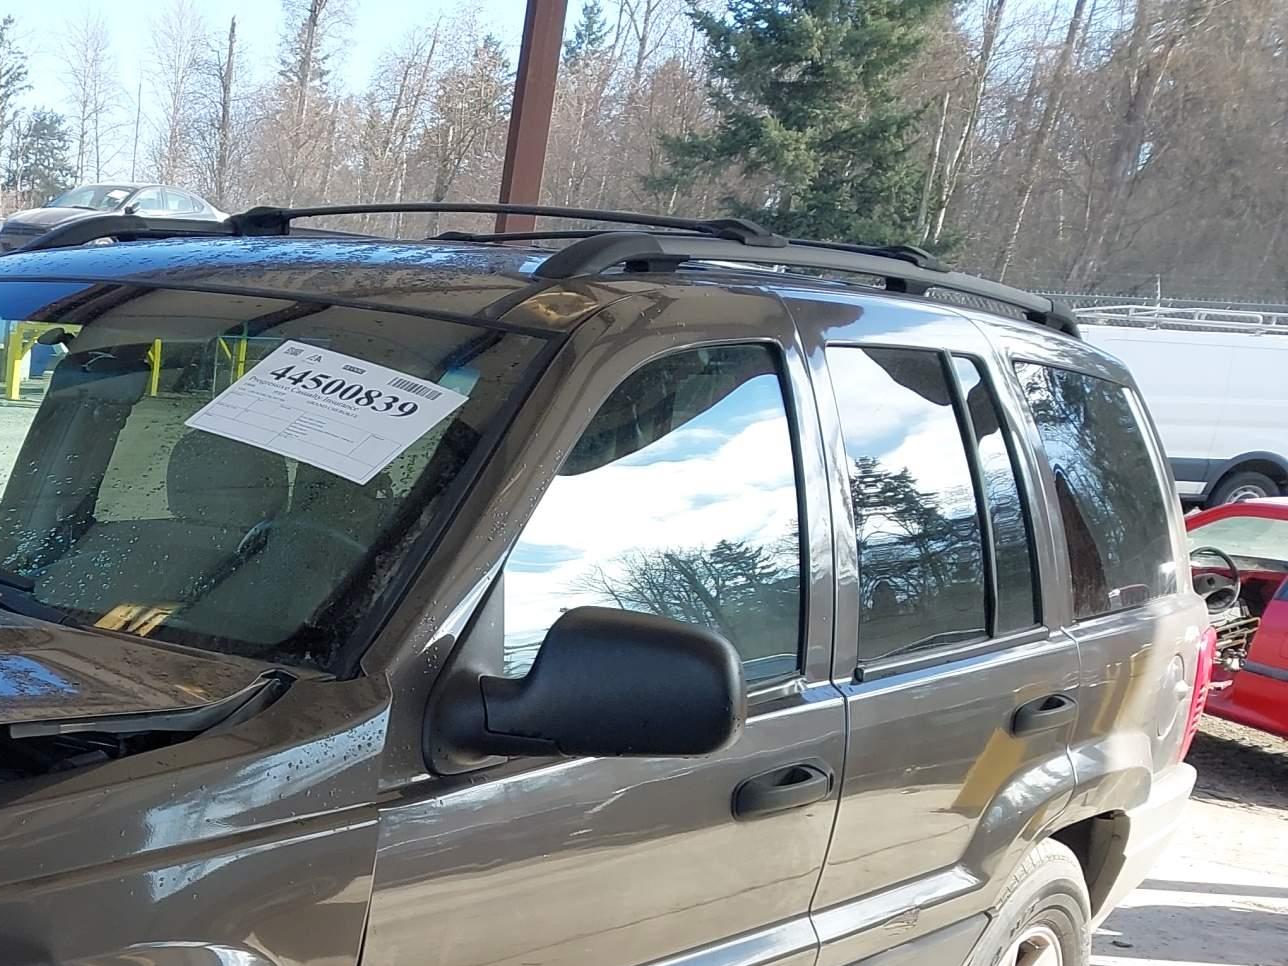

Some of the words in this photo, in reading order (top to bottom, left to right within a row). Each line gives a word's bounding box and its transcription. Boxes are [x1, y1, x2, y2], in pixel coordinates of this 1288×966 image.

[249, 376, 290, 391] Progressive
[291, 387, 323, 401] Casualty
[322, 394, 359, 412] Insurance
[269, 365, 419, 417] 44500839
